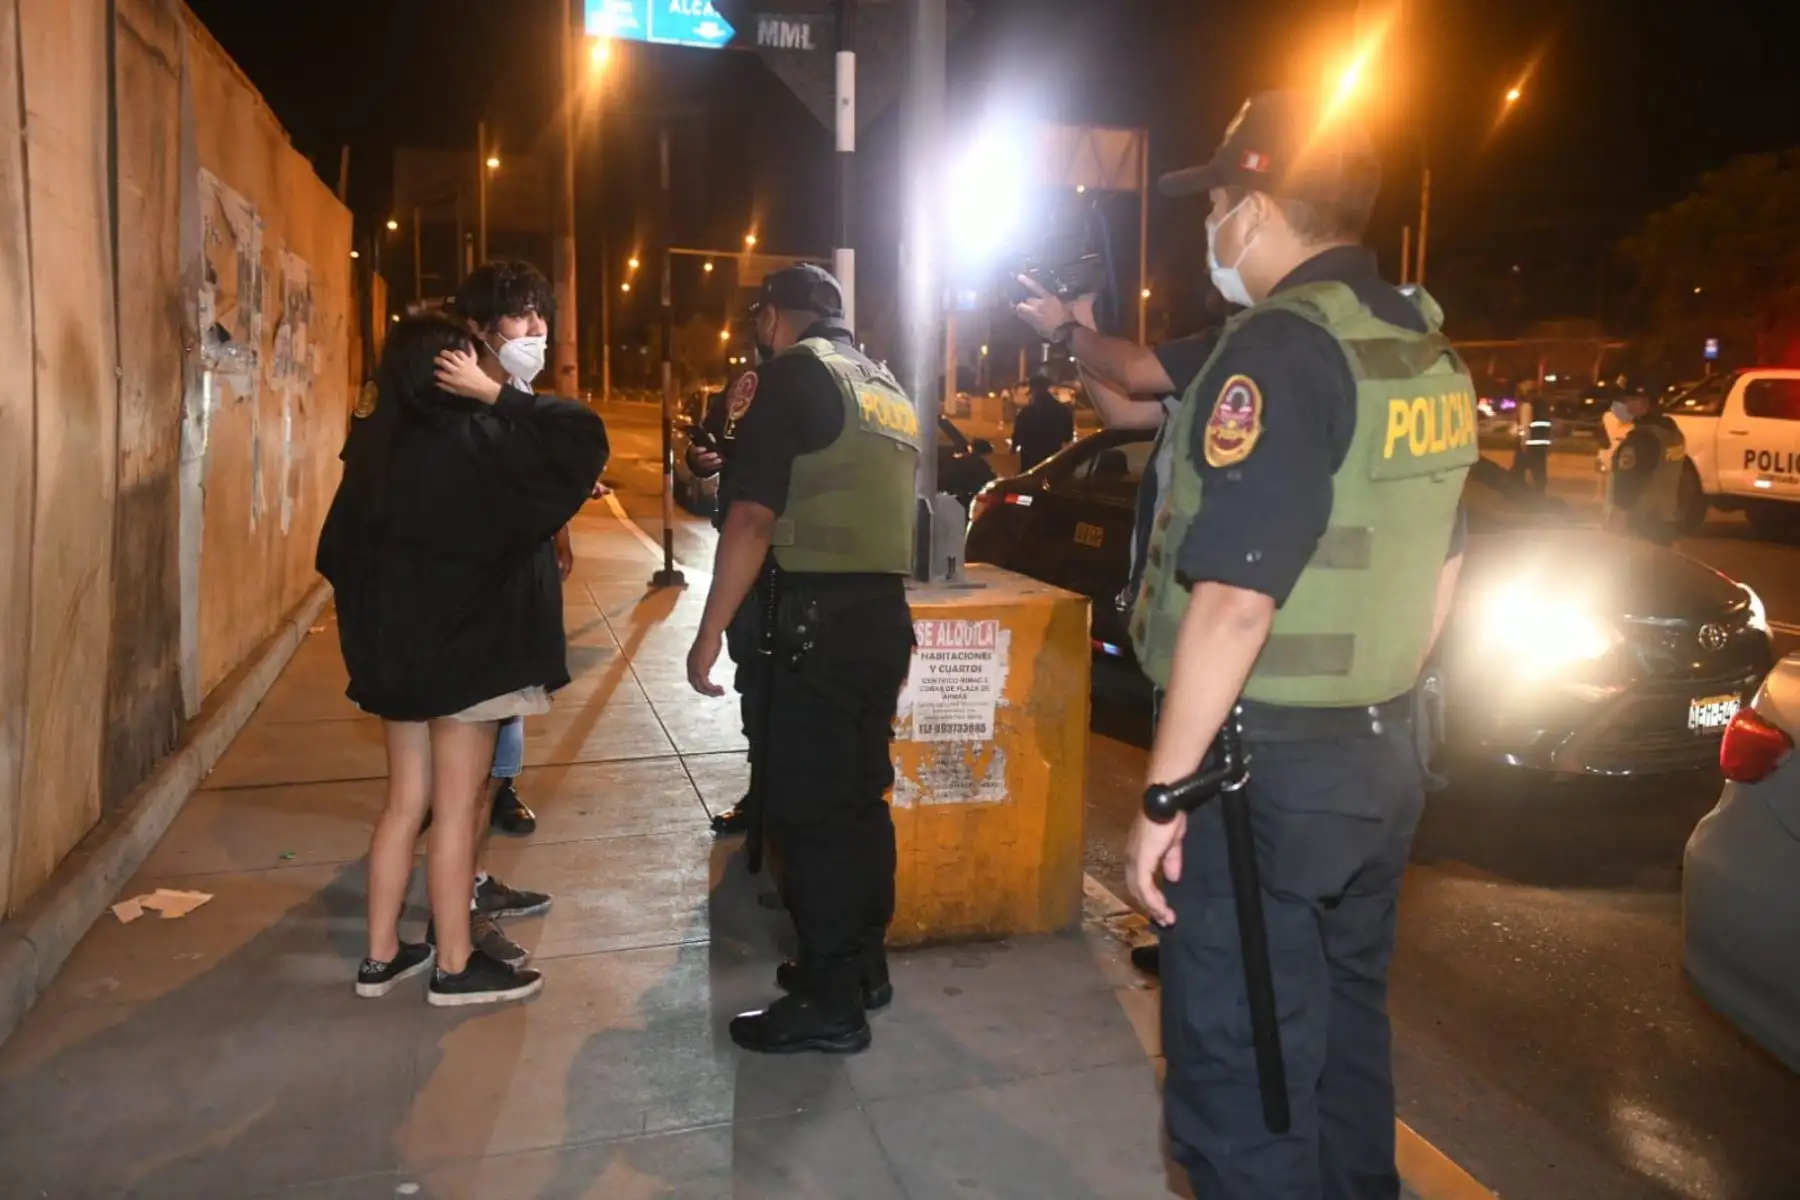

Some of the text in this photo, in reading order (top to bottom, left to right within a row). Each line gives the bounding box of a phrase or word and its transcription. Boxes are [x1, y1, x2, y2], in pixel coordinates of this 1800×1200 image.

[757, 18, 817, 50] MML
[1383, 390, 1472, 459] POLICIA
[915, 620, 994, 648] SE ALQUILA
[921, 651, 992, 660] HABITACIONES
[929, 664, 982, 673] Y CUARTOS
